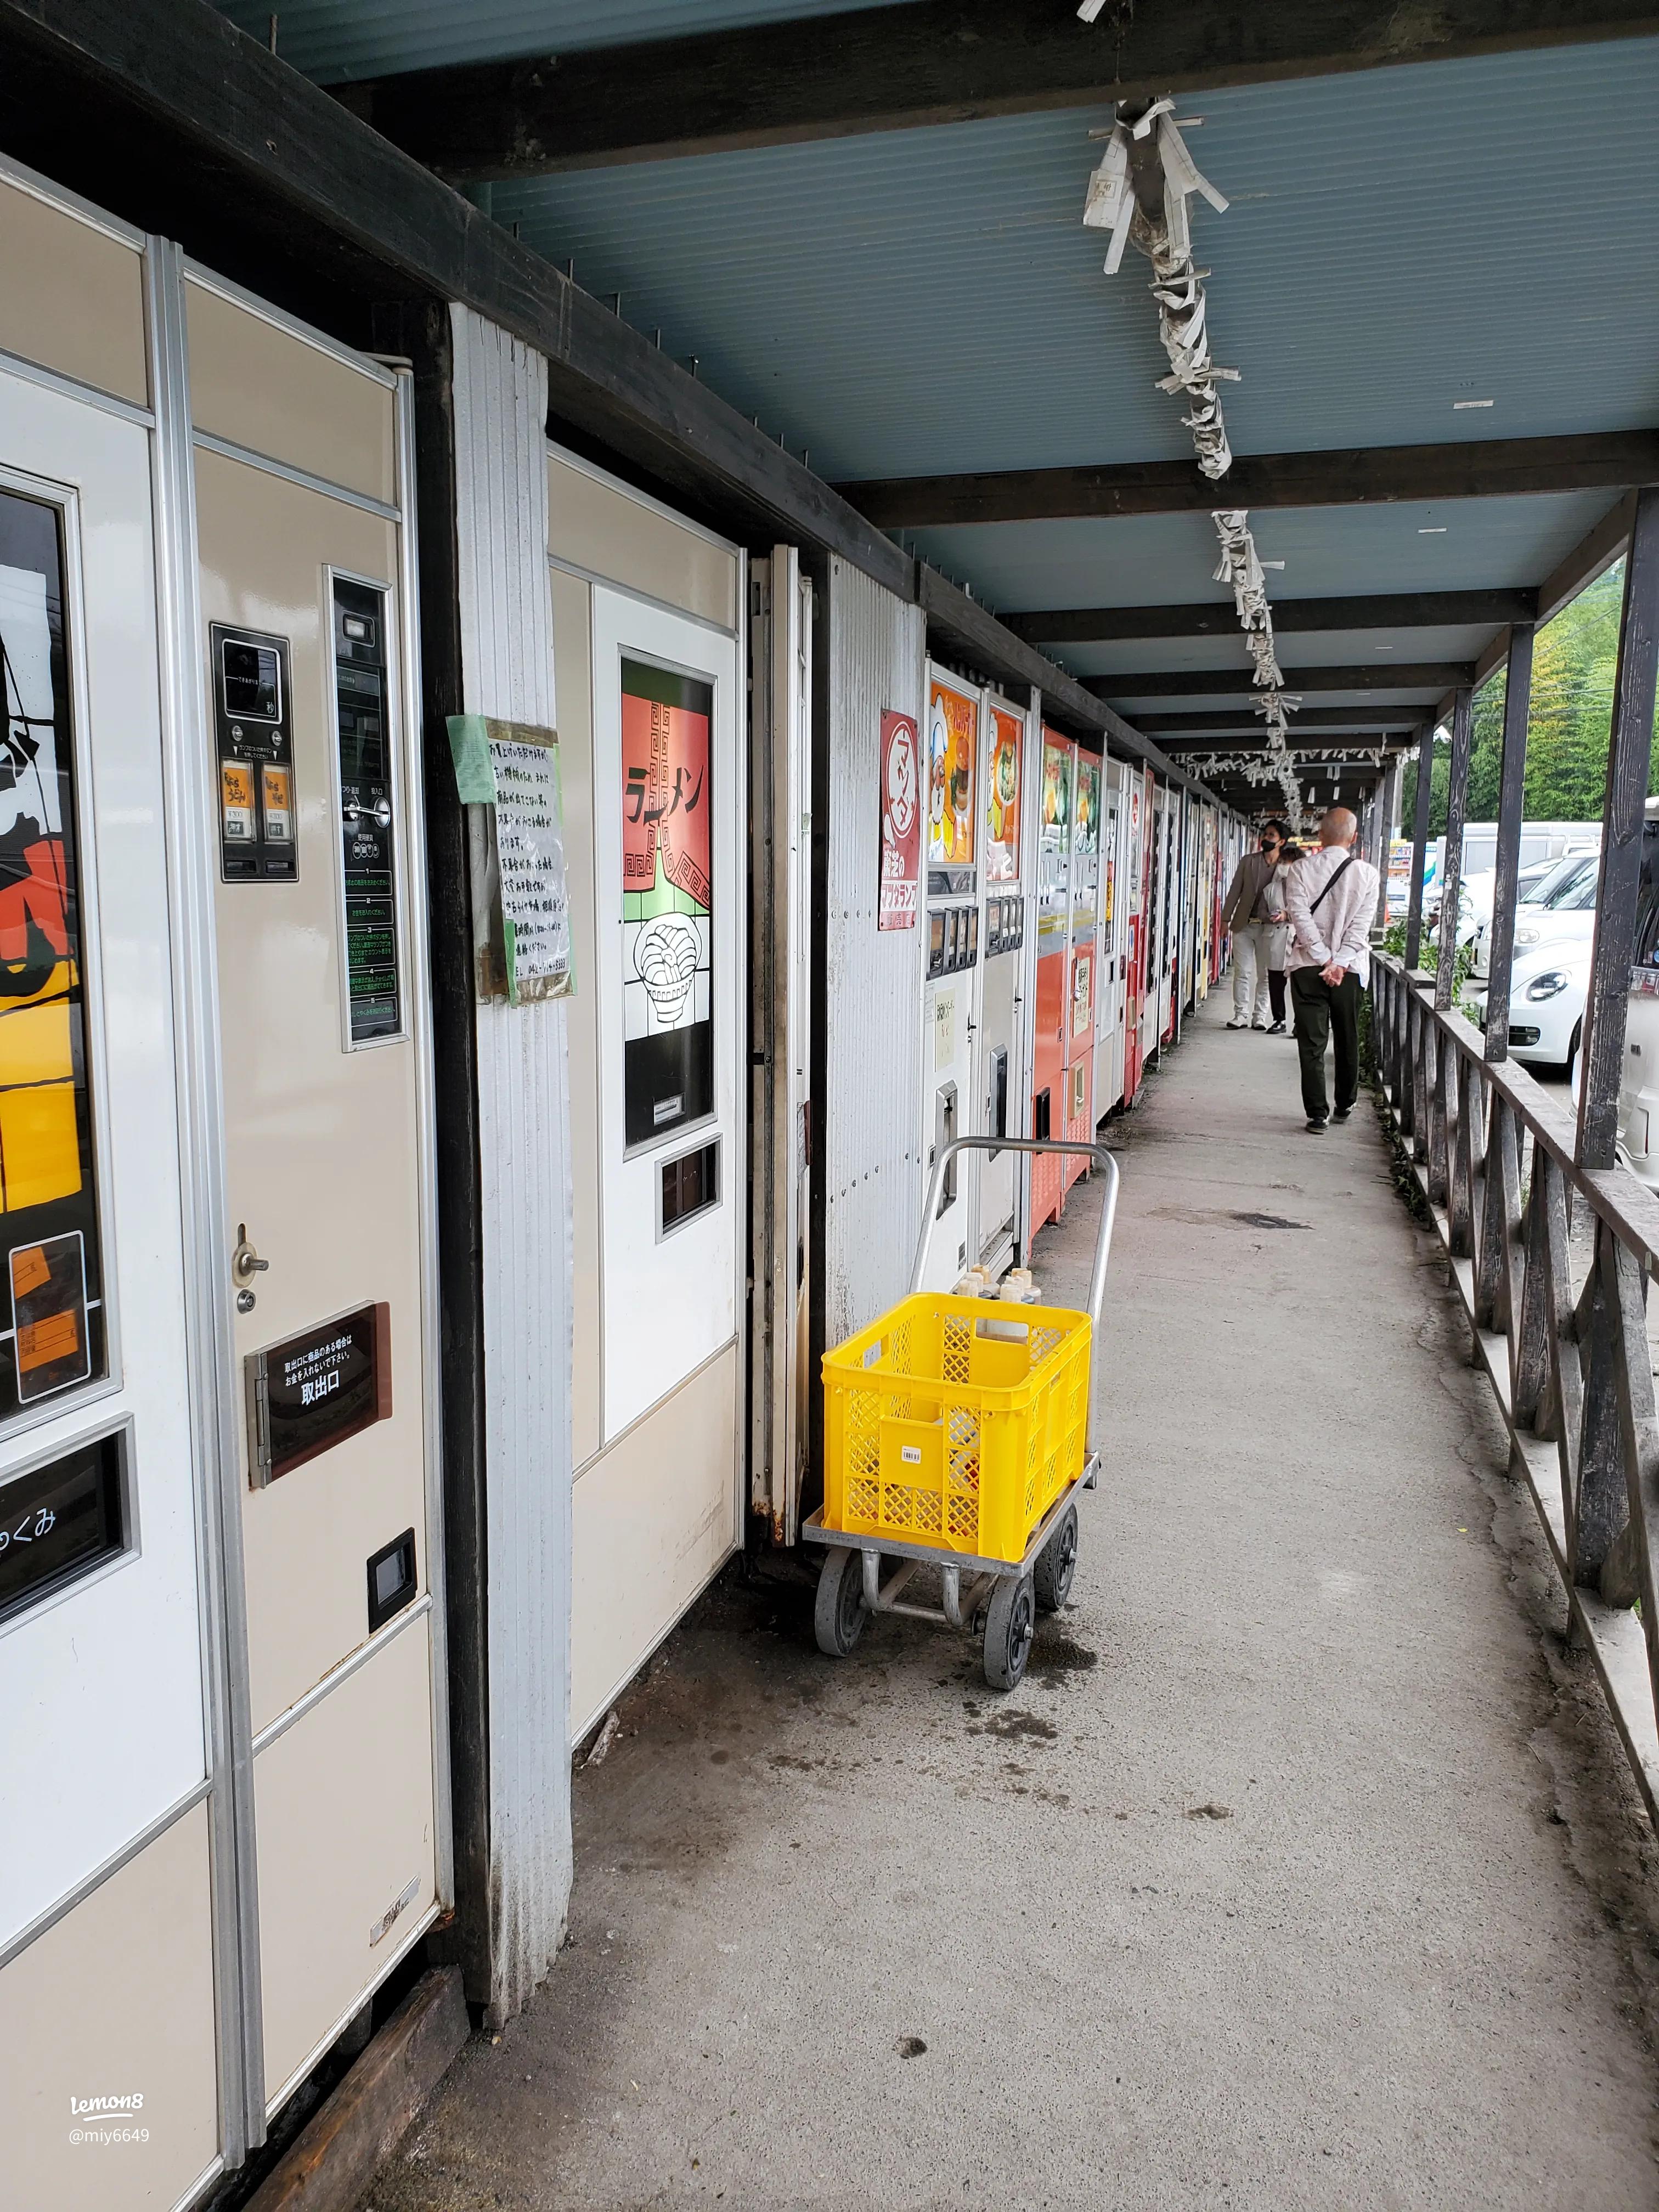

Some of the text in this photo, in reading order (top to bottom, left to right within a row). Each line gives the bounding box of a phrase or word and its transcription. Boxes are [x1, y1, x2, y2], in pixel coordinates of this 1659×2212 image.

[266, 702, 274, 714] 秒
[625, 763, 704, 830] ラーメン
[500, 835, 524, 851] あります。
[284, 1334, 352, 1374] 取出口に商品のある場合は
[285, 1352, 351, 1387] お金を入れないで下さい。
[301, 1369, 340, 1407] 取出口
